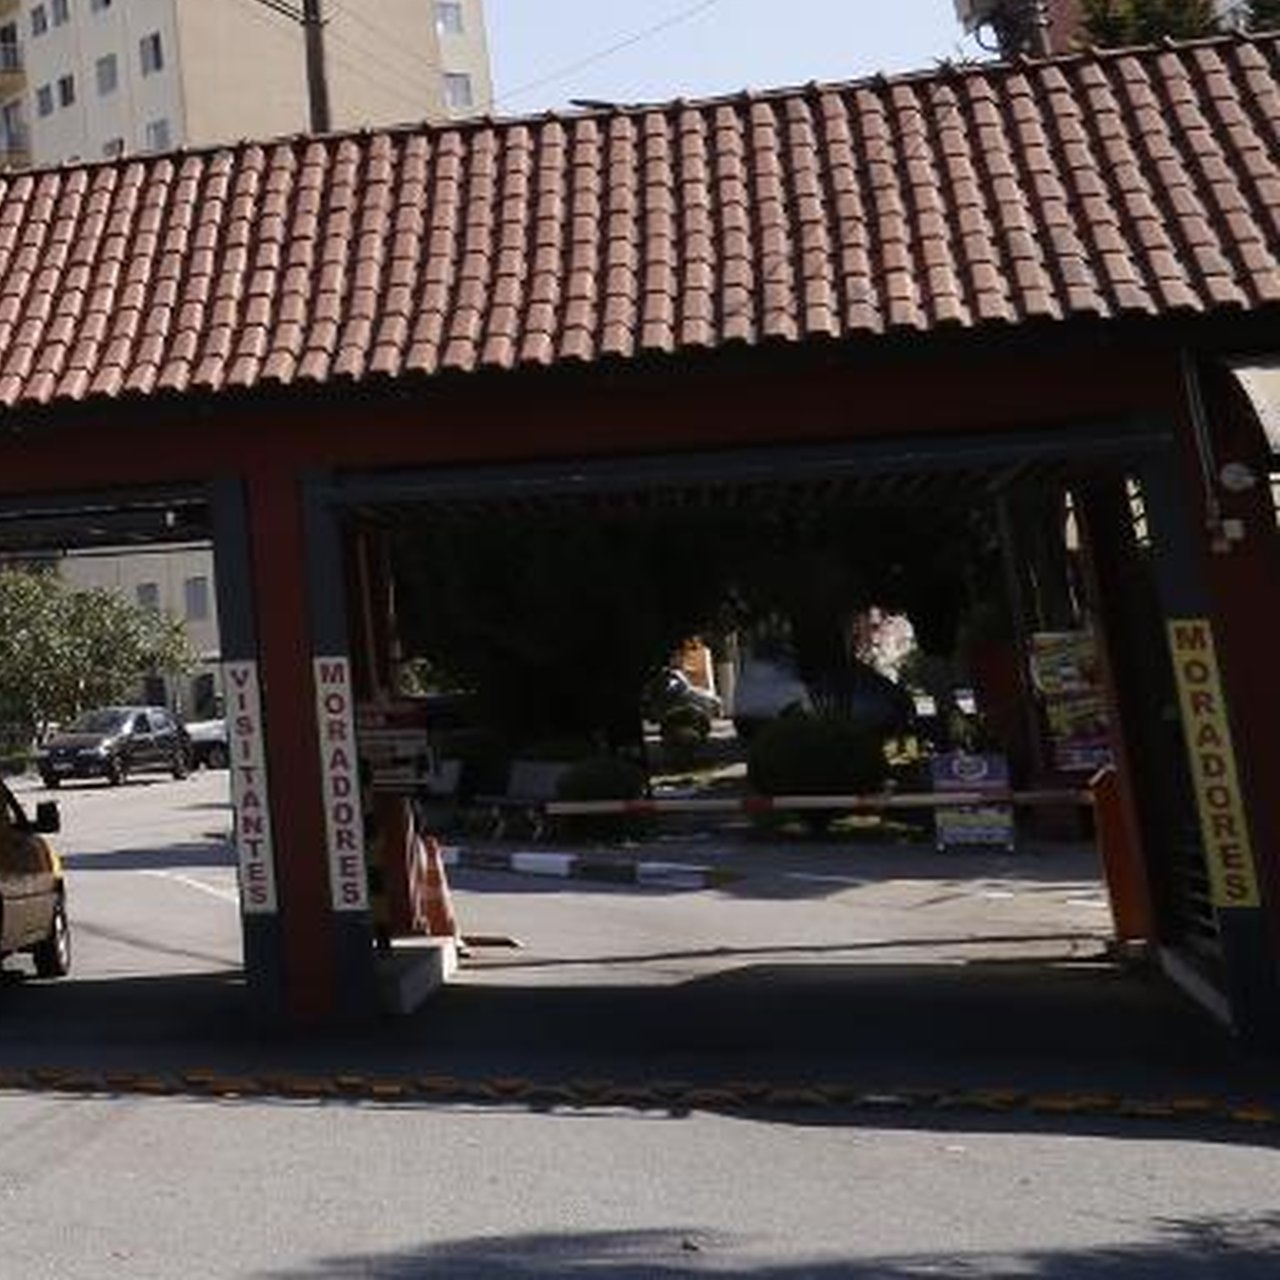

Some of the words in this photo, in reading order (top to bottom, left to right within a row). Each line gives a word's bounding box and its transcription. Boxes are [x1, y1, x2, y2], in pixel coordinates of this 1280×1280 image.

[230, 669, 268, 905] VISITANTES
[318, 662, 361, 905] MORADORES
[1173, 625, 1248, 904] MORADORES
